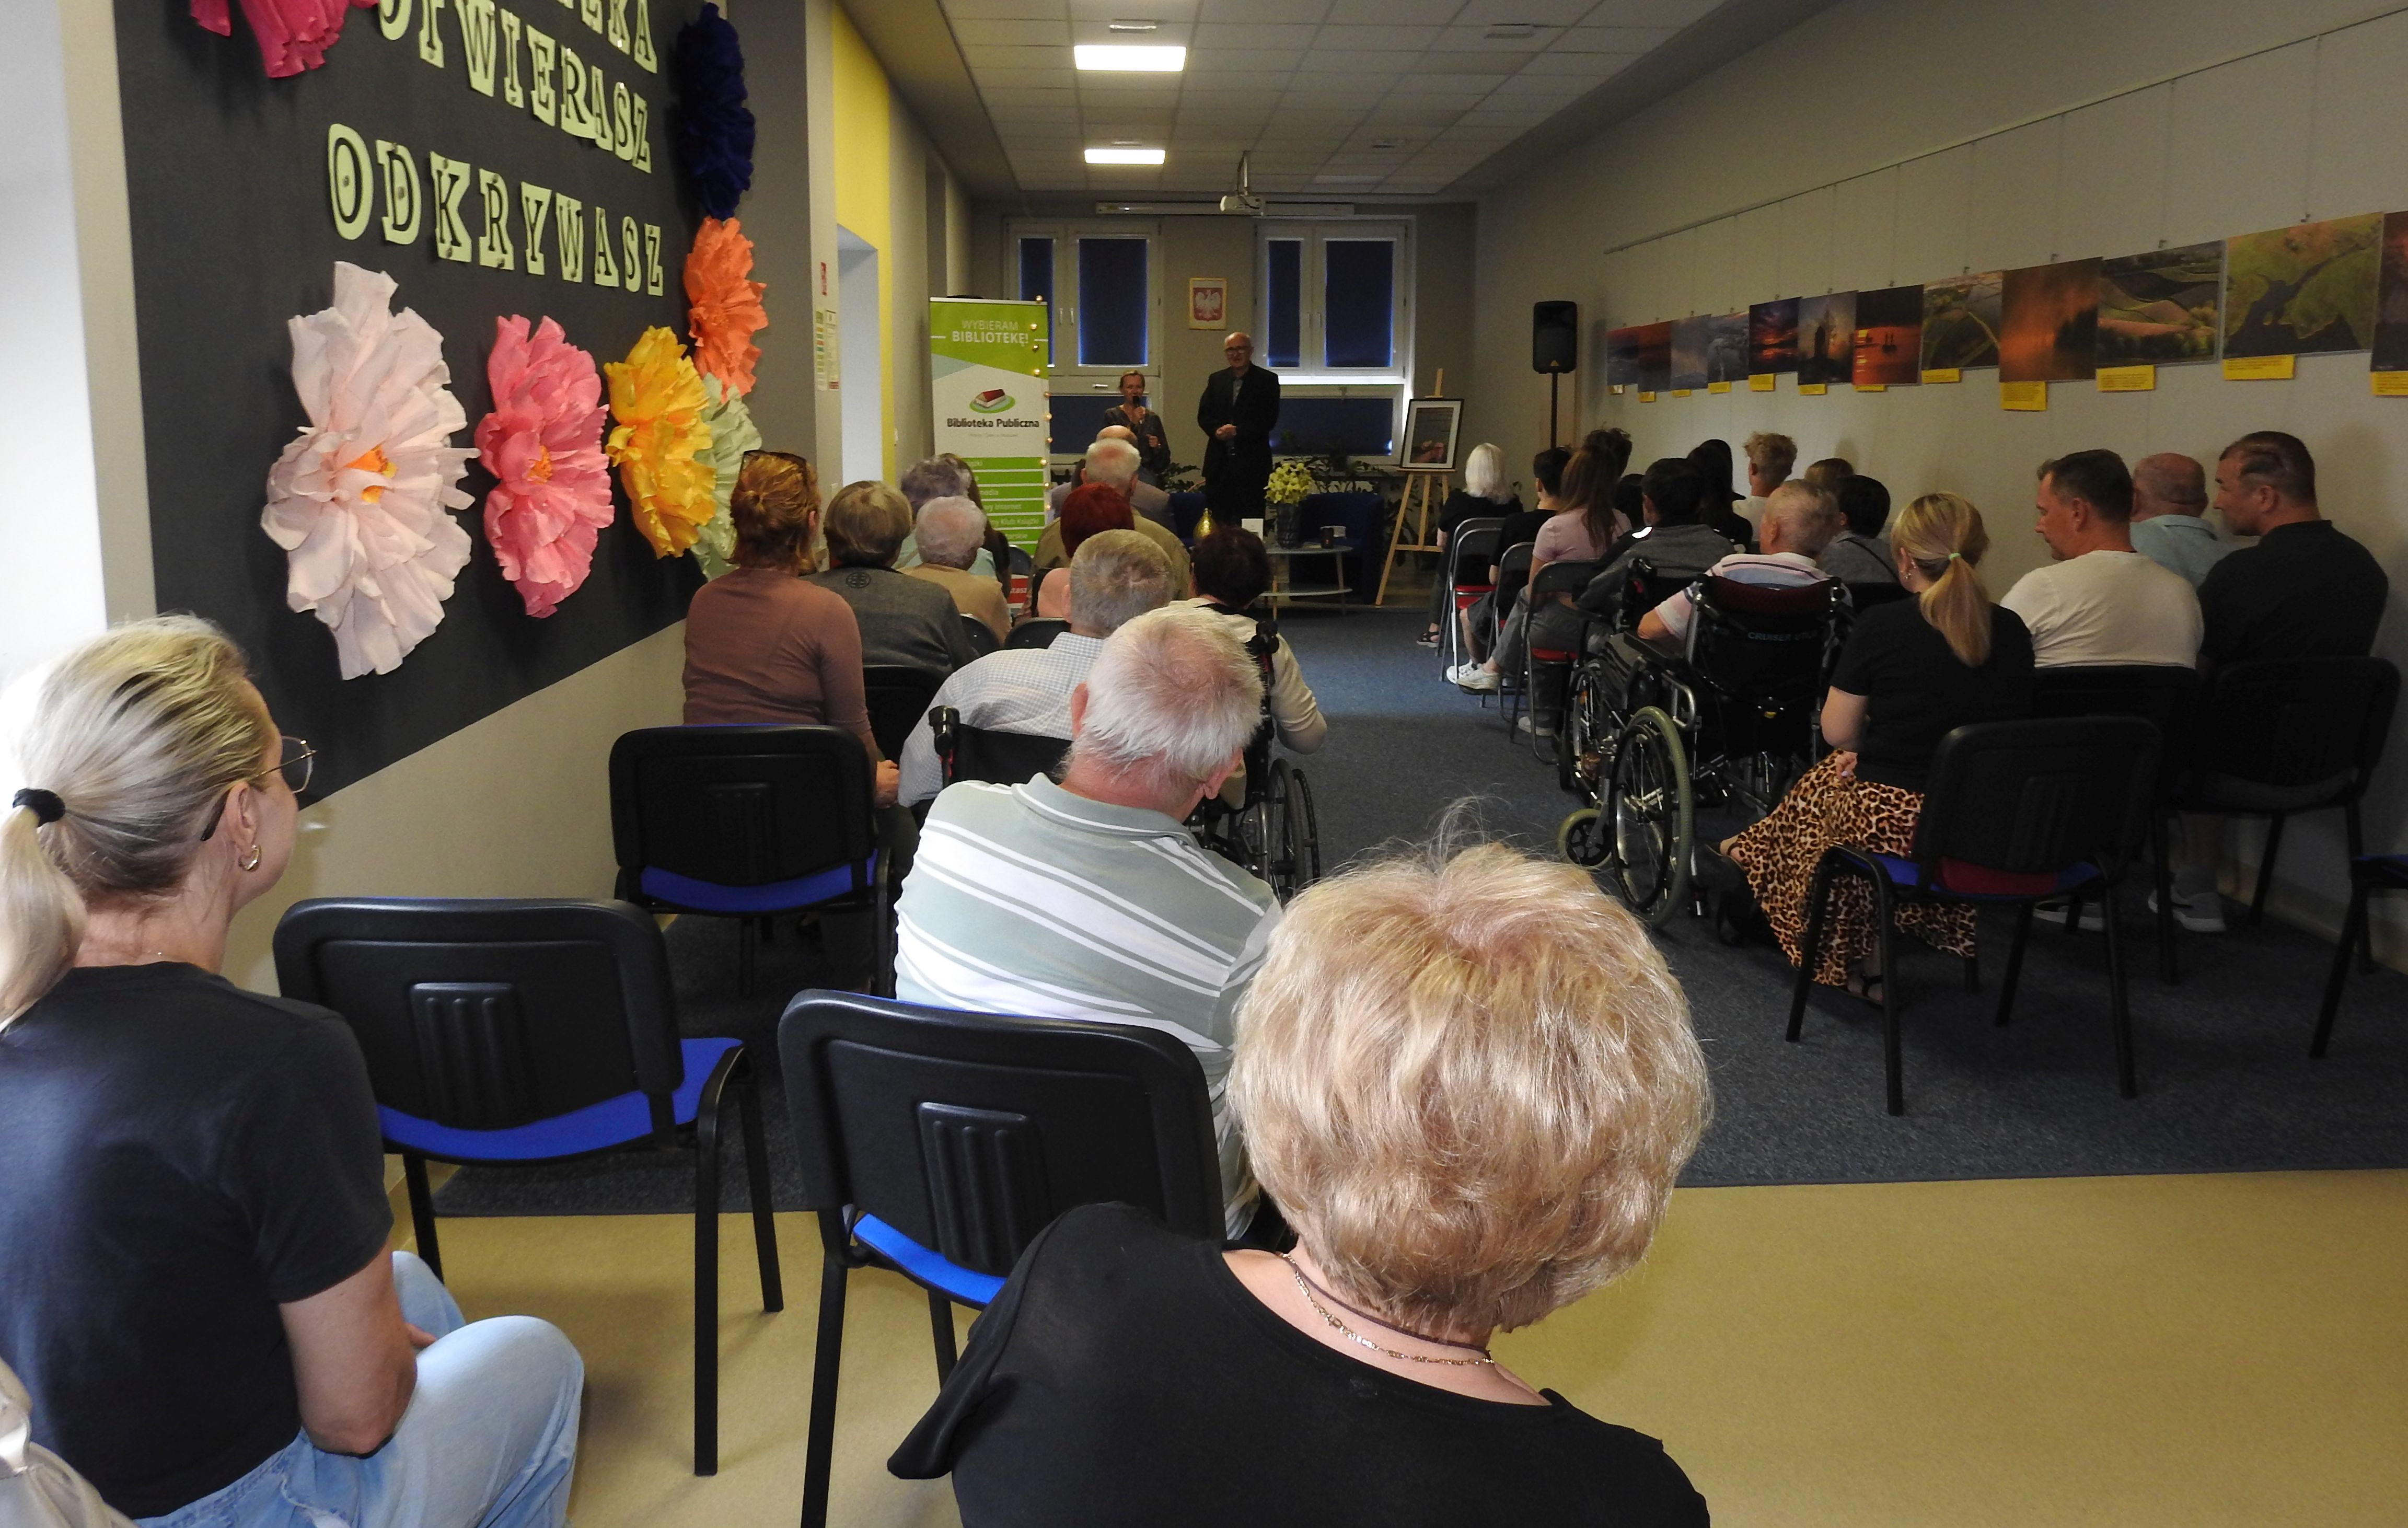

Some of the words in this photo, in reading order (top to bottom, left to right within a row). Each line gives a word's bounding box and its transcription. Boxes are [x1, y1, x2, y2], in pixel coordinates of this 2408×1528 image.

[328, 123, 663, 296] ODKRYWASZ
[962, 320, 1019, 331] WYBIERAM
[952, 331, 1029, 347] BIBLIOTEKĘ!
[947, 418, 993, 427] Biblioteka
[997, 419, 1039, 427] Publiczna
[1747, 631, 1791, 641] CRUISER
